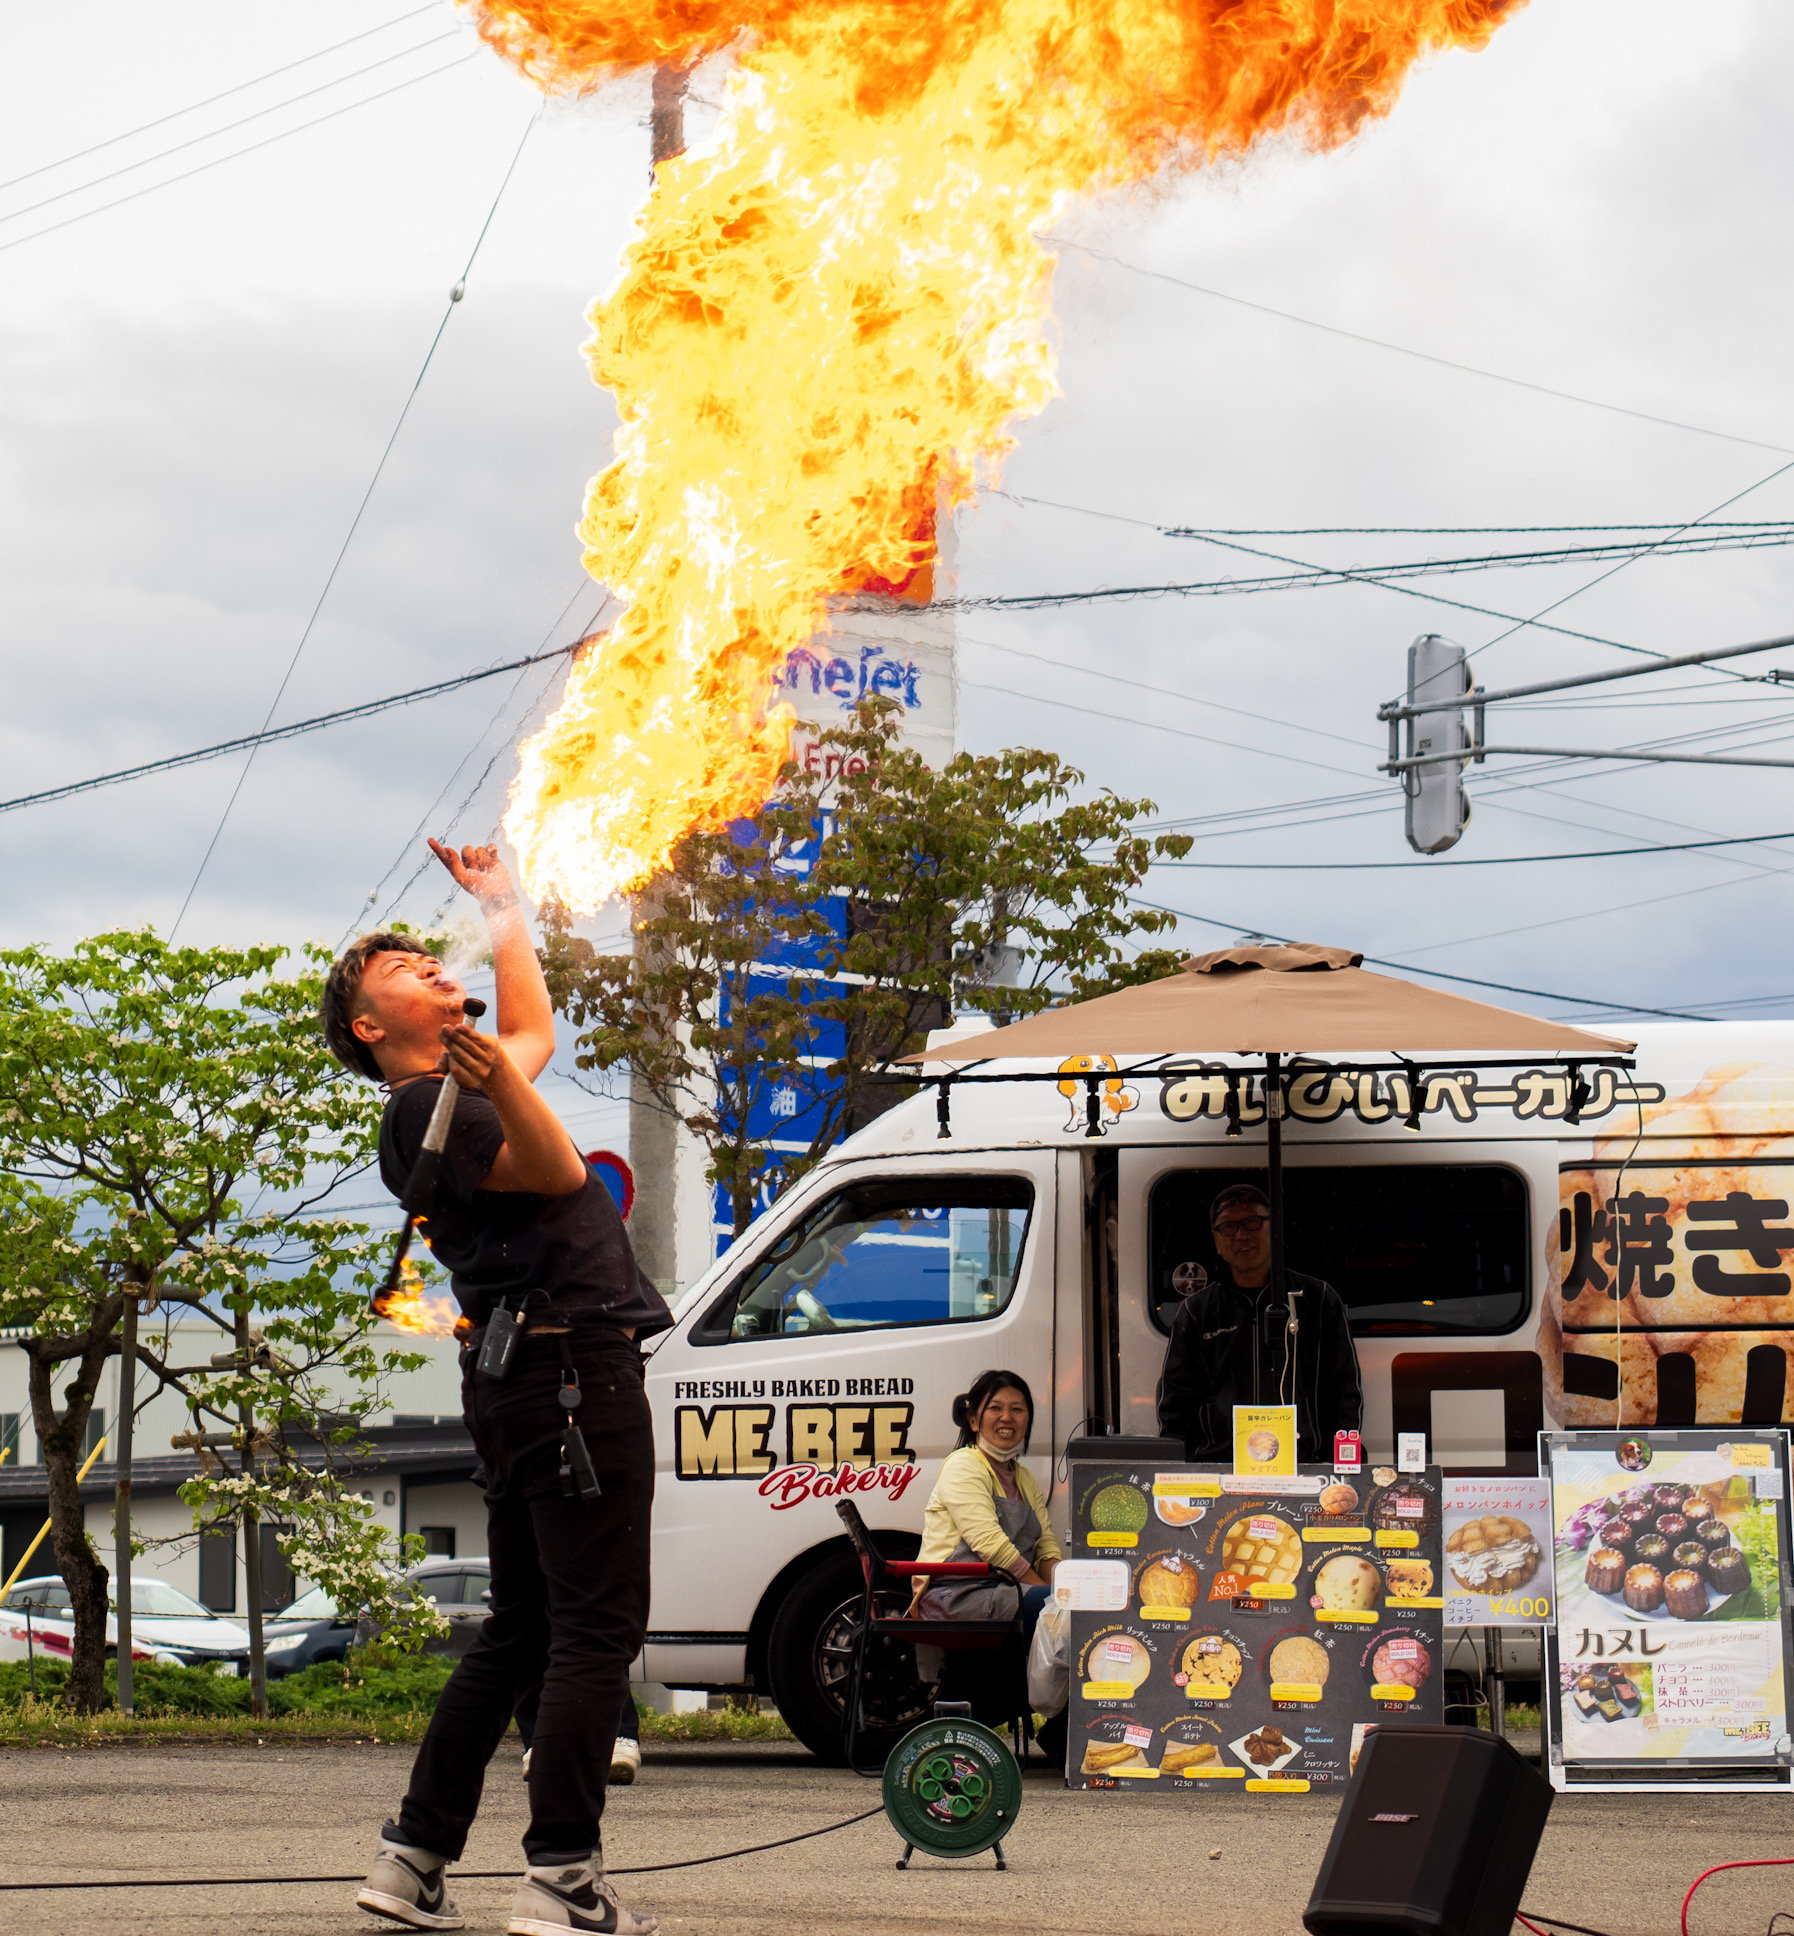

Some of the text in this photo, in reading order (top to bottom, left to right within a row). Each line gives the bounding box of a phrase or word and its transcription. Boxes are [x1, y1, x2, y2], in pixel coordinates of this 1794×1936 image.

[675, 1377, 914, 1399] FRESHLY BAKED BREAD
[675, 1401, 916, 1481] ME BEE
[758, 1464, 922, 1510] Bakery
[1443, 1498, 1549, 1510] メロンパンホイップ
[1266, 1500, 1304, 1521] プレーン
[1252, 1519, 1277, 1530] 売り切れ
[1382, 1549, 1401, 1557] ¥250
[1218, 1575, 1236, 1585] 人気
[1489, 1597, 1549, 1617] ¥400
[1448, 1615, 1474, 1623] イチゴ
[1151, 1622, 1171, 1630] ¥250
[1126, 1626, 1158, 1652] リッチミルク
[1575, 1627, 1667, 1657] カヌレ
[1707, 1635, 1718, 1645] de
[1721, 1631, 1762, 1643] Bordeaux
[1107, 1643, 1132, 1654] 売り切れ
[1107, 1651, 1120, 1659] SOLD
[1657, 1663, 1736, 1673] バニラ 300円
[1658, 1675, 1735, 1685] チョコ 300円
[1708, 1688, 1735, 1697] 300円
[1194, 1700, 1213, 1708] ¥250
[1658, 1698, 1762, 1709] ストロベリー 300円
[1717, 1716, 1744, 1726] 300円
[1181, 1723, 1203, 1731] スイート
[1304, 1726, 1321, 1734] Mini
[1303, 1760, 1340, 1768] クロワッサン
[1094, 1779, 1114, 1787] ¥250
